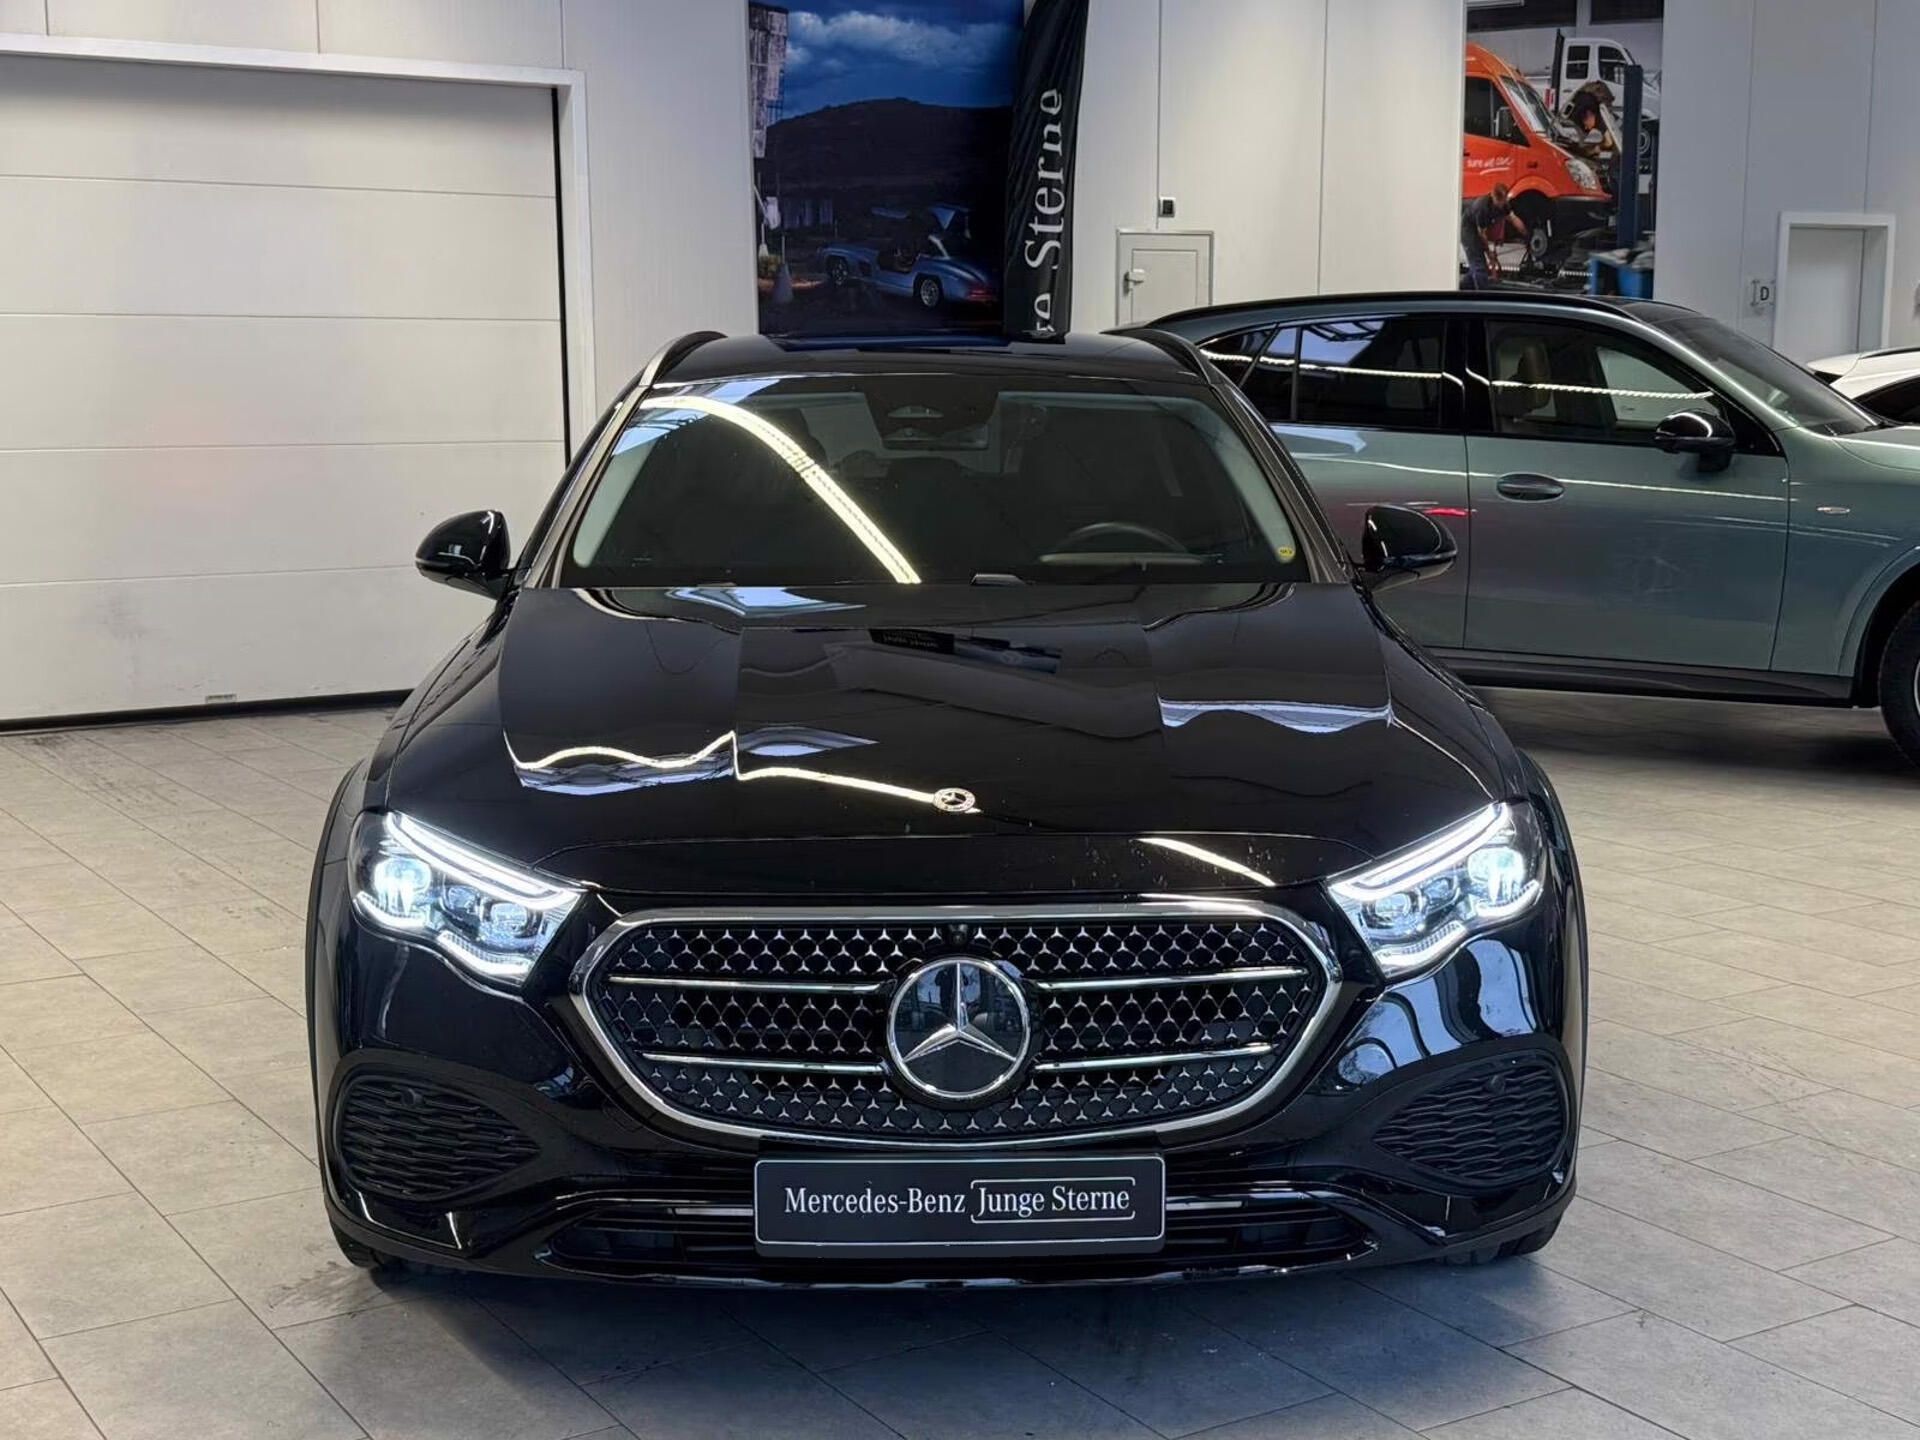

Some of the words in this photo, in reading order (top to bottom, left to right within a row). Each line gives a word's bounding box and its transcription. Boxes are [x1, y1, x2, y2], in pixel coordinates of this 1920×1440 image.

[1024, 88, 1065, 270] Sterne
[1760, 286, 1770, 301] D
[784, 1187, 966, 1214] Mercedes-Benz
[978, 1187, 1045, 1218] Junge
[1051, 1185, 1130, 1211] Sterne
